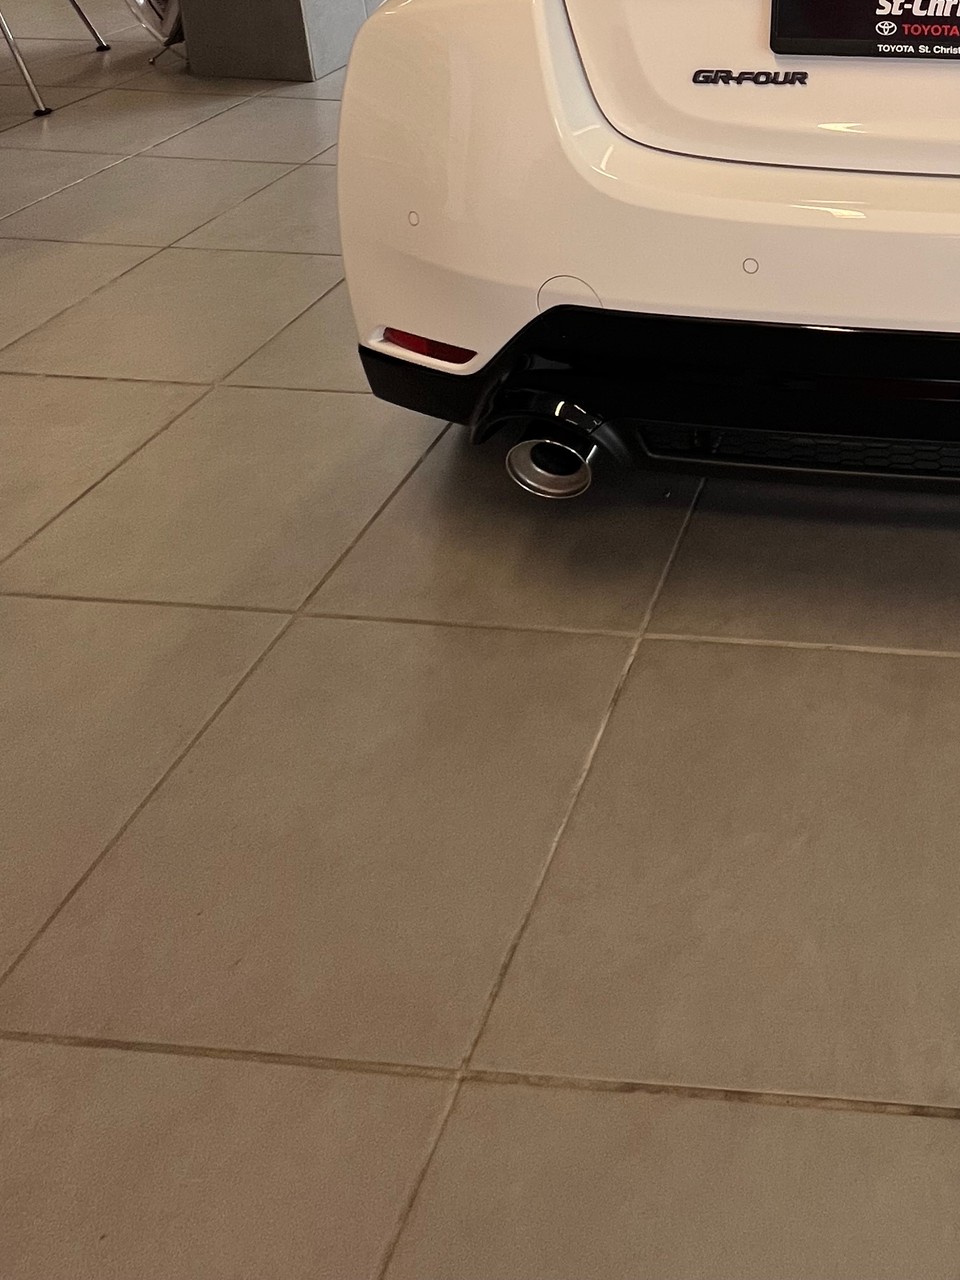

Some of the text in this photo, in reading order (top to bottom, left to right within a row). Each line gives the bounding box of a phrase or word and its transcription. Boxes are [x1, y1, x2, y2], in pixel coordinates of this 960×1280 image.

[902, 24, 960, 37] TOYOTA
[877, 44, 915, 53] TOYOTA
[918, 44, 931, 54] St.
[692, 70, 809, 85] GR-FOUR
